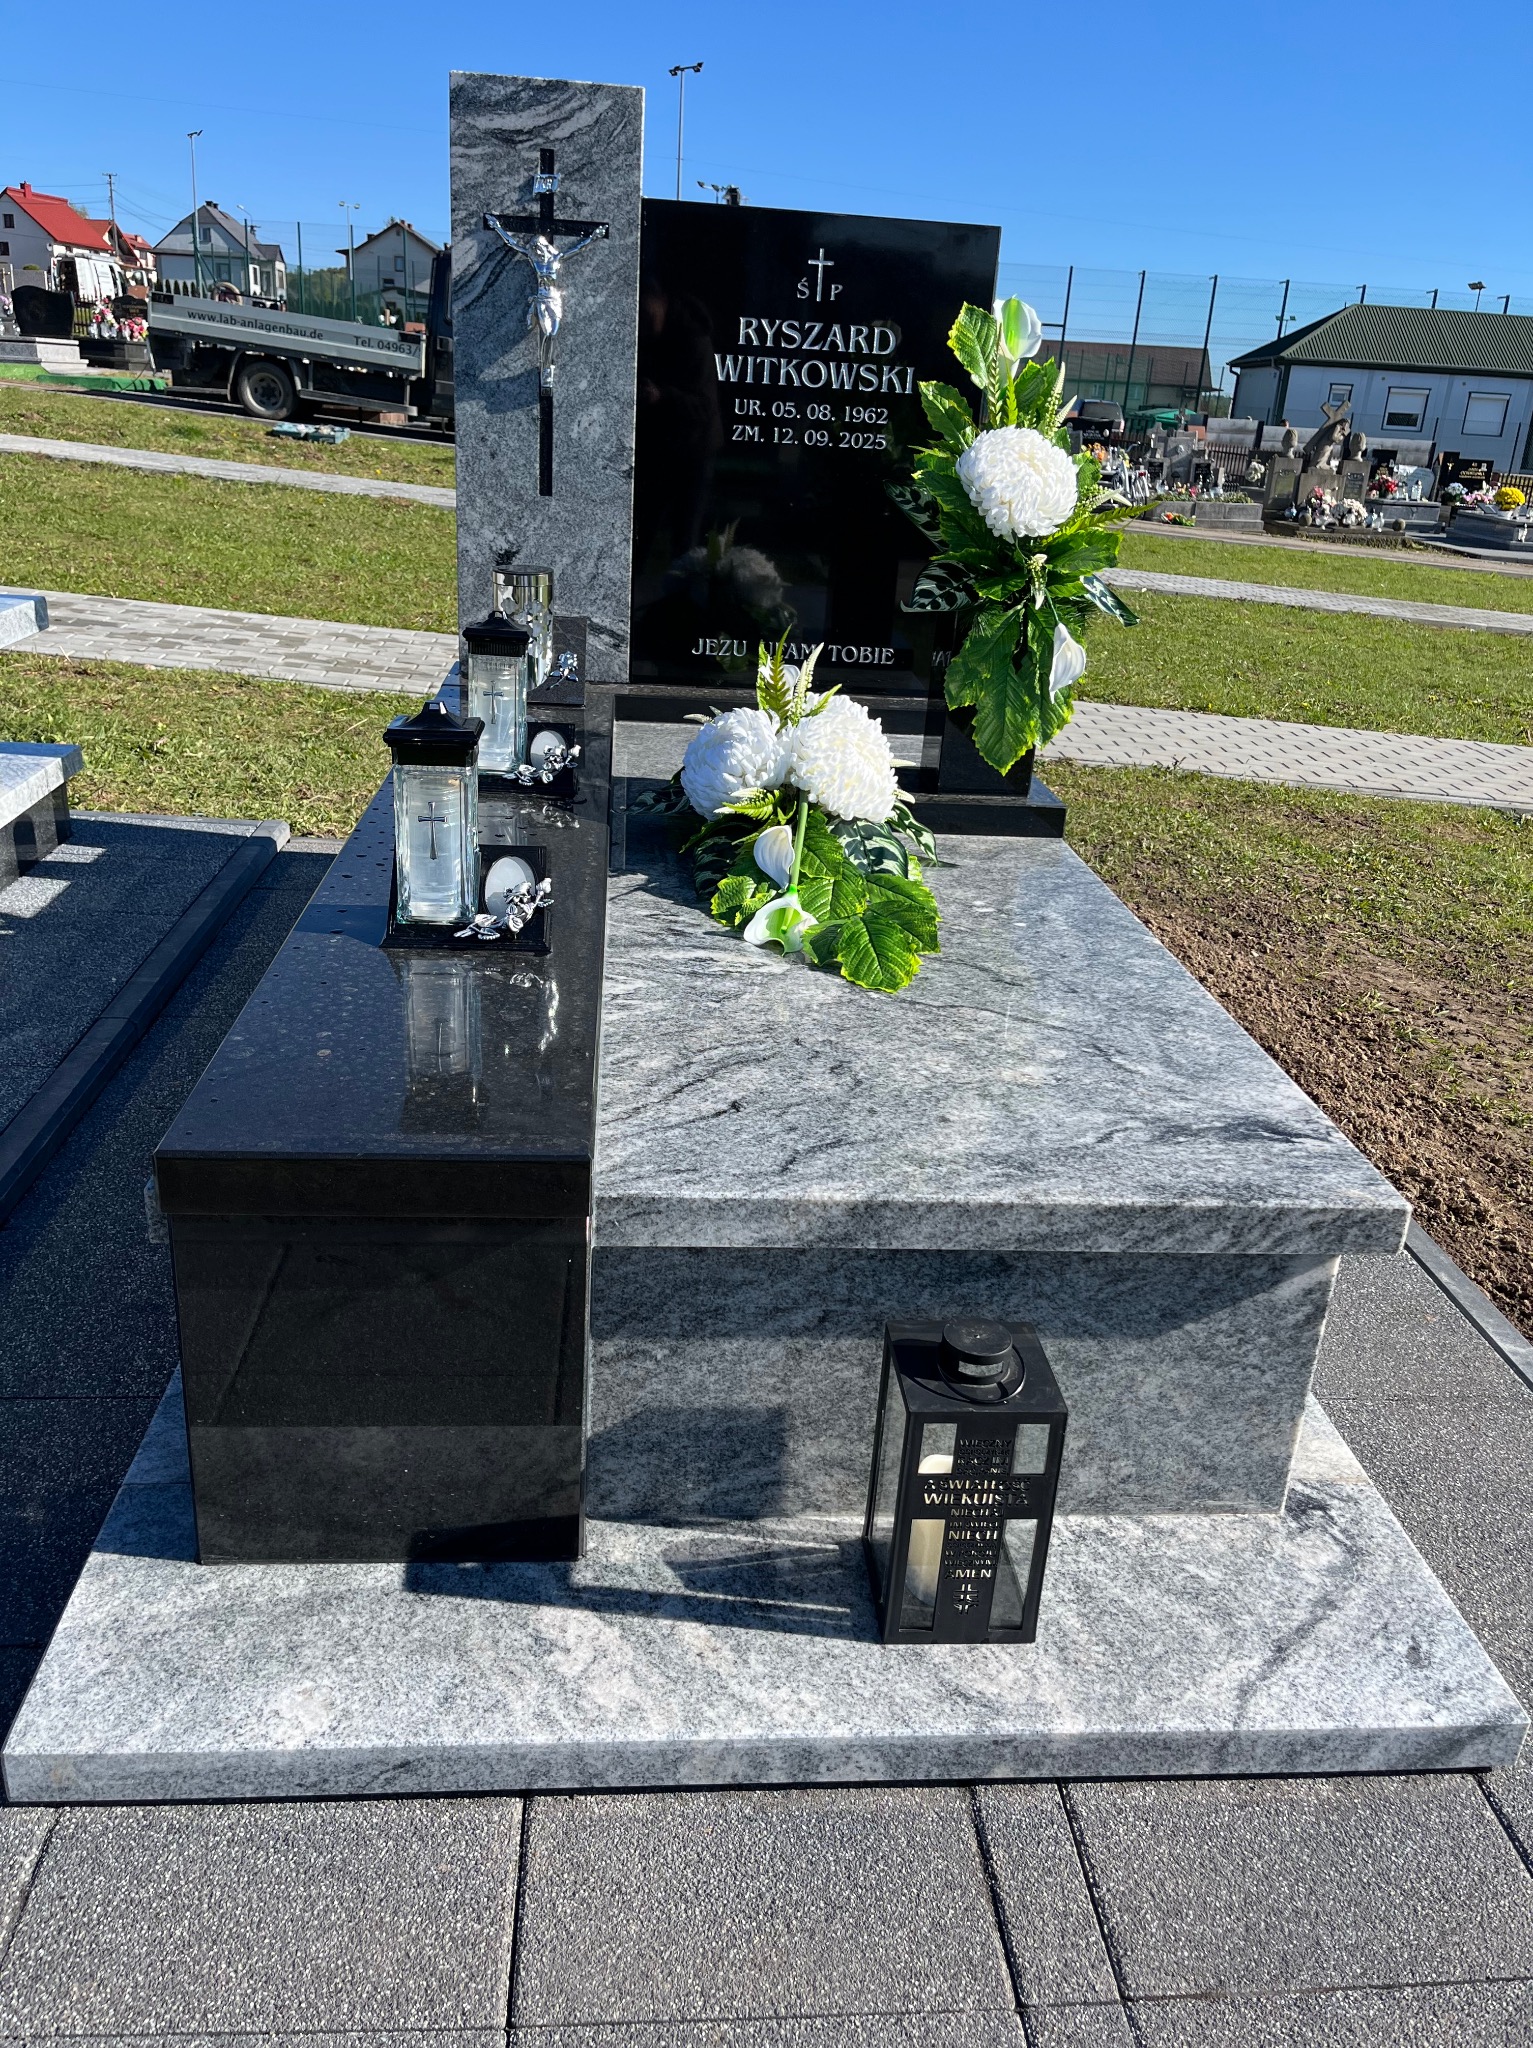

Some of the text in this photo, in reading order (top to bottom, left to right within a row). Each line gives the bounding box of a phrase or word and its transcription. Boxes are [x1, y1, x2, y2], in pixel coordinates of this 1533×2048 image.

[830, 283, 844, 301] P
[187, 308, 421, 358] www.lab-anlagenbau.de Tel. 04963/
[737, 316, 897, 354] RYSZARD
[713, 352, 915, 395] WITKOWSKI
[734, 398, 767, 417] UR.
[731, 424, 765, 442] ZM.
[691, 637, 748, 657] JEZU
[828, 644, 895, 665] TOBIE
[924, 1480, 936, 1490] A
[923, 1493, 1029, 1506] WIEKUISTA
[948, 1530, 998, 1541] NIECH
[945, 1568, 992, 1579] AMEN
